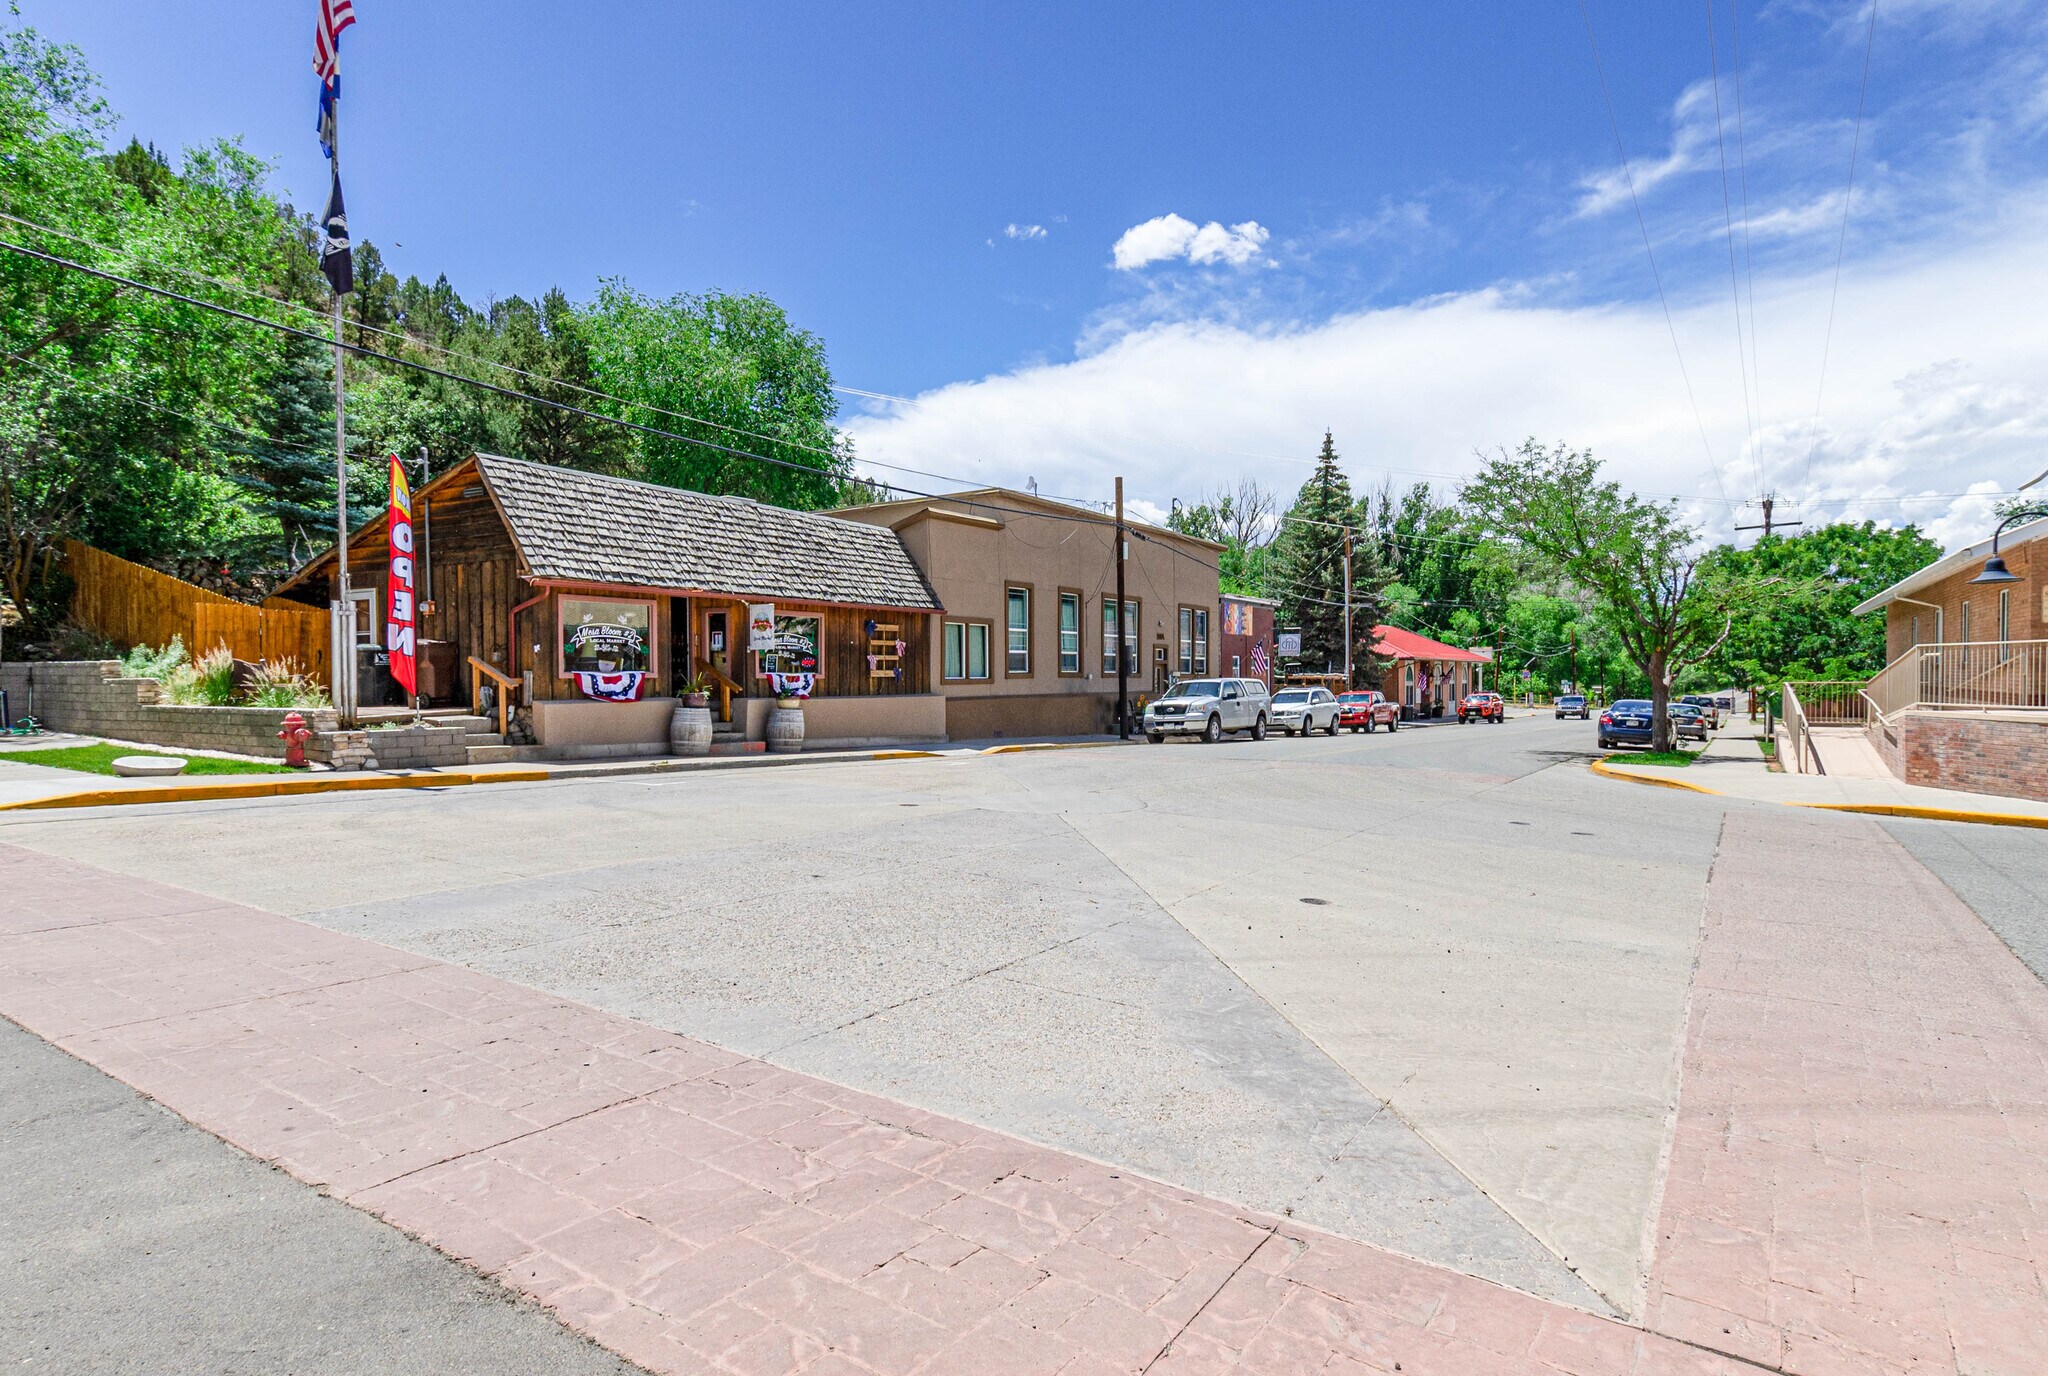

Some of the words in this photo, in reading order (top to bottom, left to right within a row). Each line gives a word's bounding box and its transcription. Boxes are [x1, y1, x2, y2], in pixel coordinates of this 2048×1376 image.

[582, 628, 600, 636] Mesa
[601, 626, 622, 636] Bloom
[624, 630, 634, 638] #2
